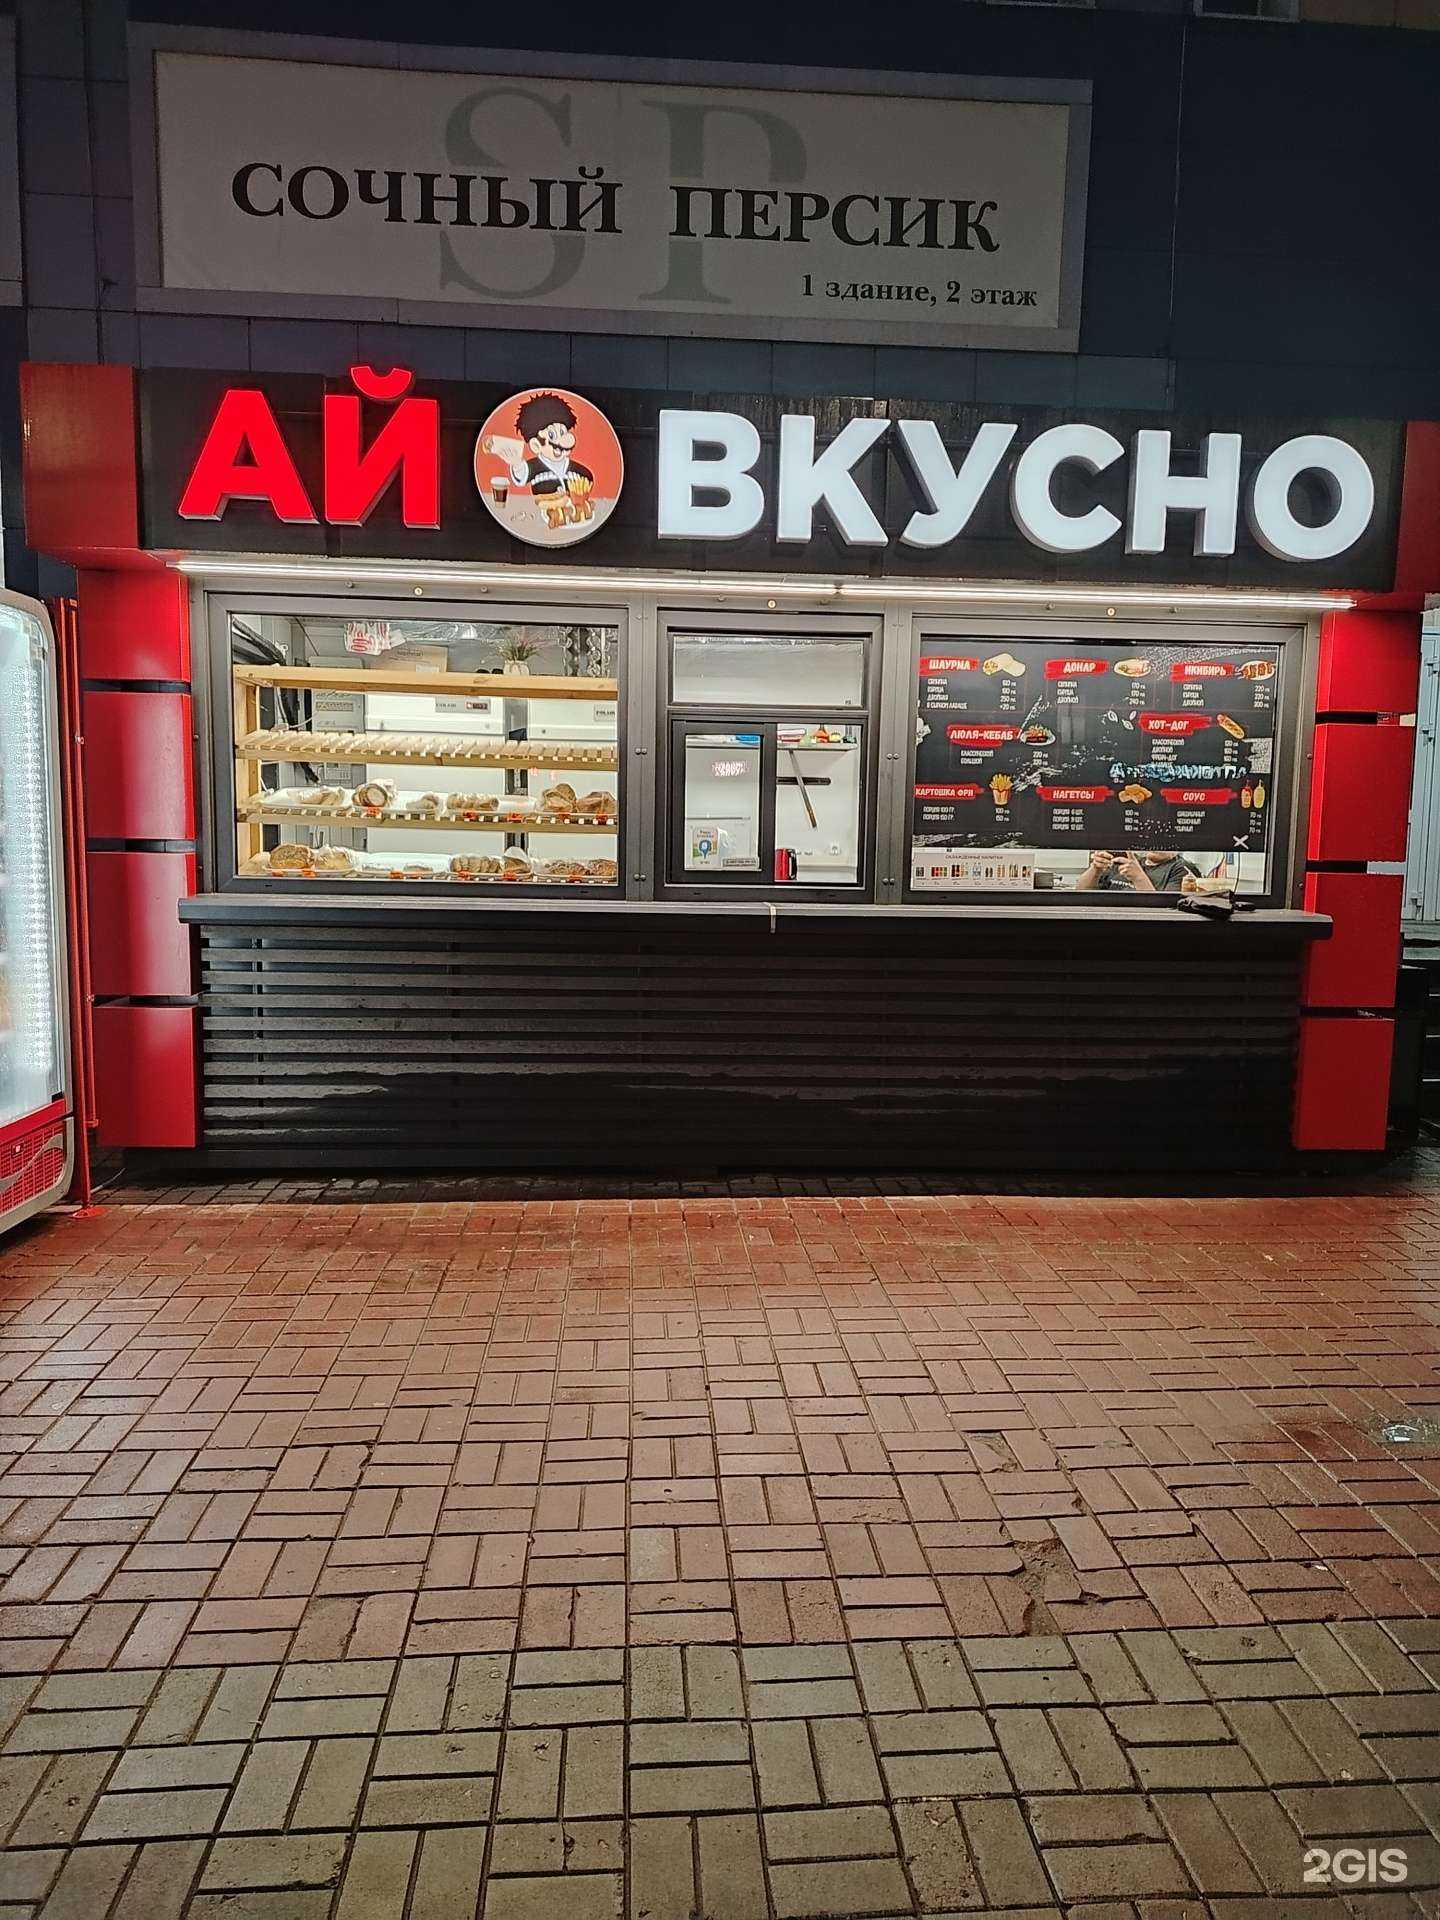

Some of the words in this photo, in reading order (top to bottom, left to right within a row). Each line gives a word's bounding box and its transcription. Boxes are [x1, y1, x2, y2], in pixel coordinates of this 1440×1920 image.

[231, 162, 623, 234] СОЧНЫЙ
[669, 185, 1000, 252] ПЕРСИК
[802, 274, 813, 297] 1
[825, 279, 937, 306] здание,
[946, 280, 961, 303] 2
[971, 286, 1038, 307] этаж
[178, 365, 440, 530] АЙ
[658, 409, 1375, 562] ВКУСНО
[929, 659, 971, 670] ШАУРМА
[1063, 661, 1096, 673] ДОНАР
[1147, 720, 1190, 730] ХОТ-ДОГ
[950, 730, 1014, 740] ЛЮЛЯ-КЕБАБ
[915, 788, 955, 797] КАРТОШКА
[1052, 790, 1095, 799] НАГЕТСЫ
[1182, 792, 1206, 801] СОУС
